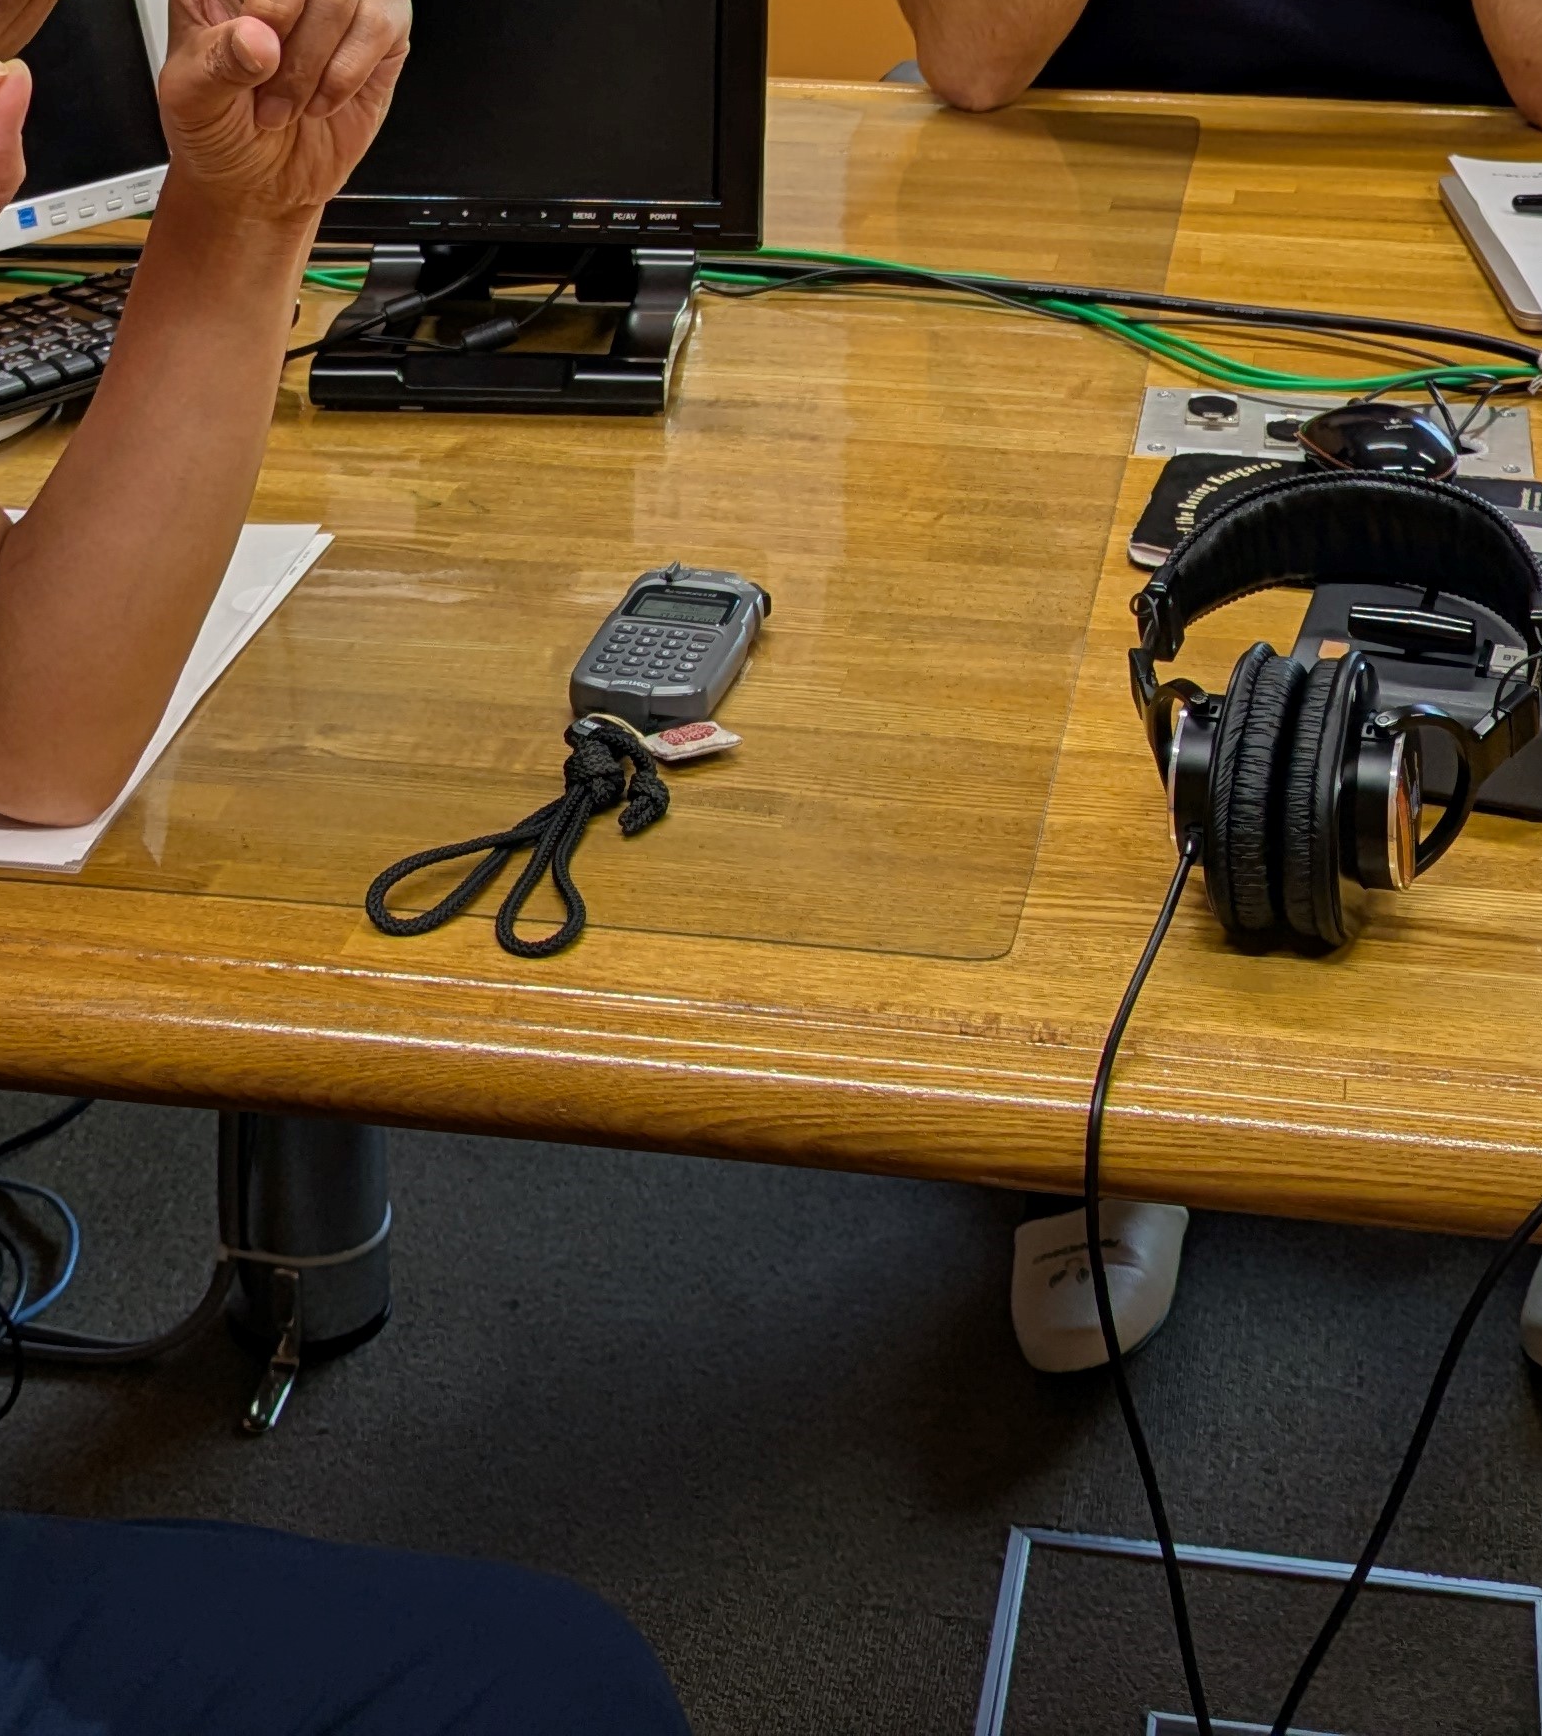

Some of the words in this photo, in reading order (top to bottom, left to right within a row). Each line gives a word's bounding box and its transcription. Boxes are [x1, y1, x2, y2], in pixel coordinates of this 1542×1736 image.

[572, 212, 596, 220] MENU
[613, 212, 637, 221] PC/AV
[649, 212, 678, 221] POWER
[1207, 461, 1282, 486] Kangaroo
[1177, 483, 1219, 510] Boxing
[1175, 511, 1195, 525] the
[1502, 654, 1519, 662] BT
[610, 679, 651, 689] SEIKO
